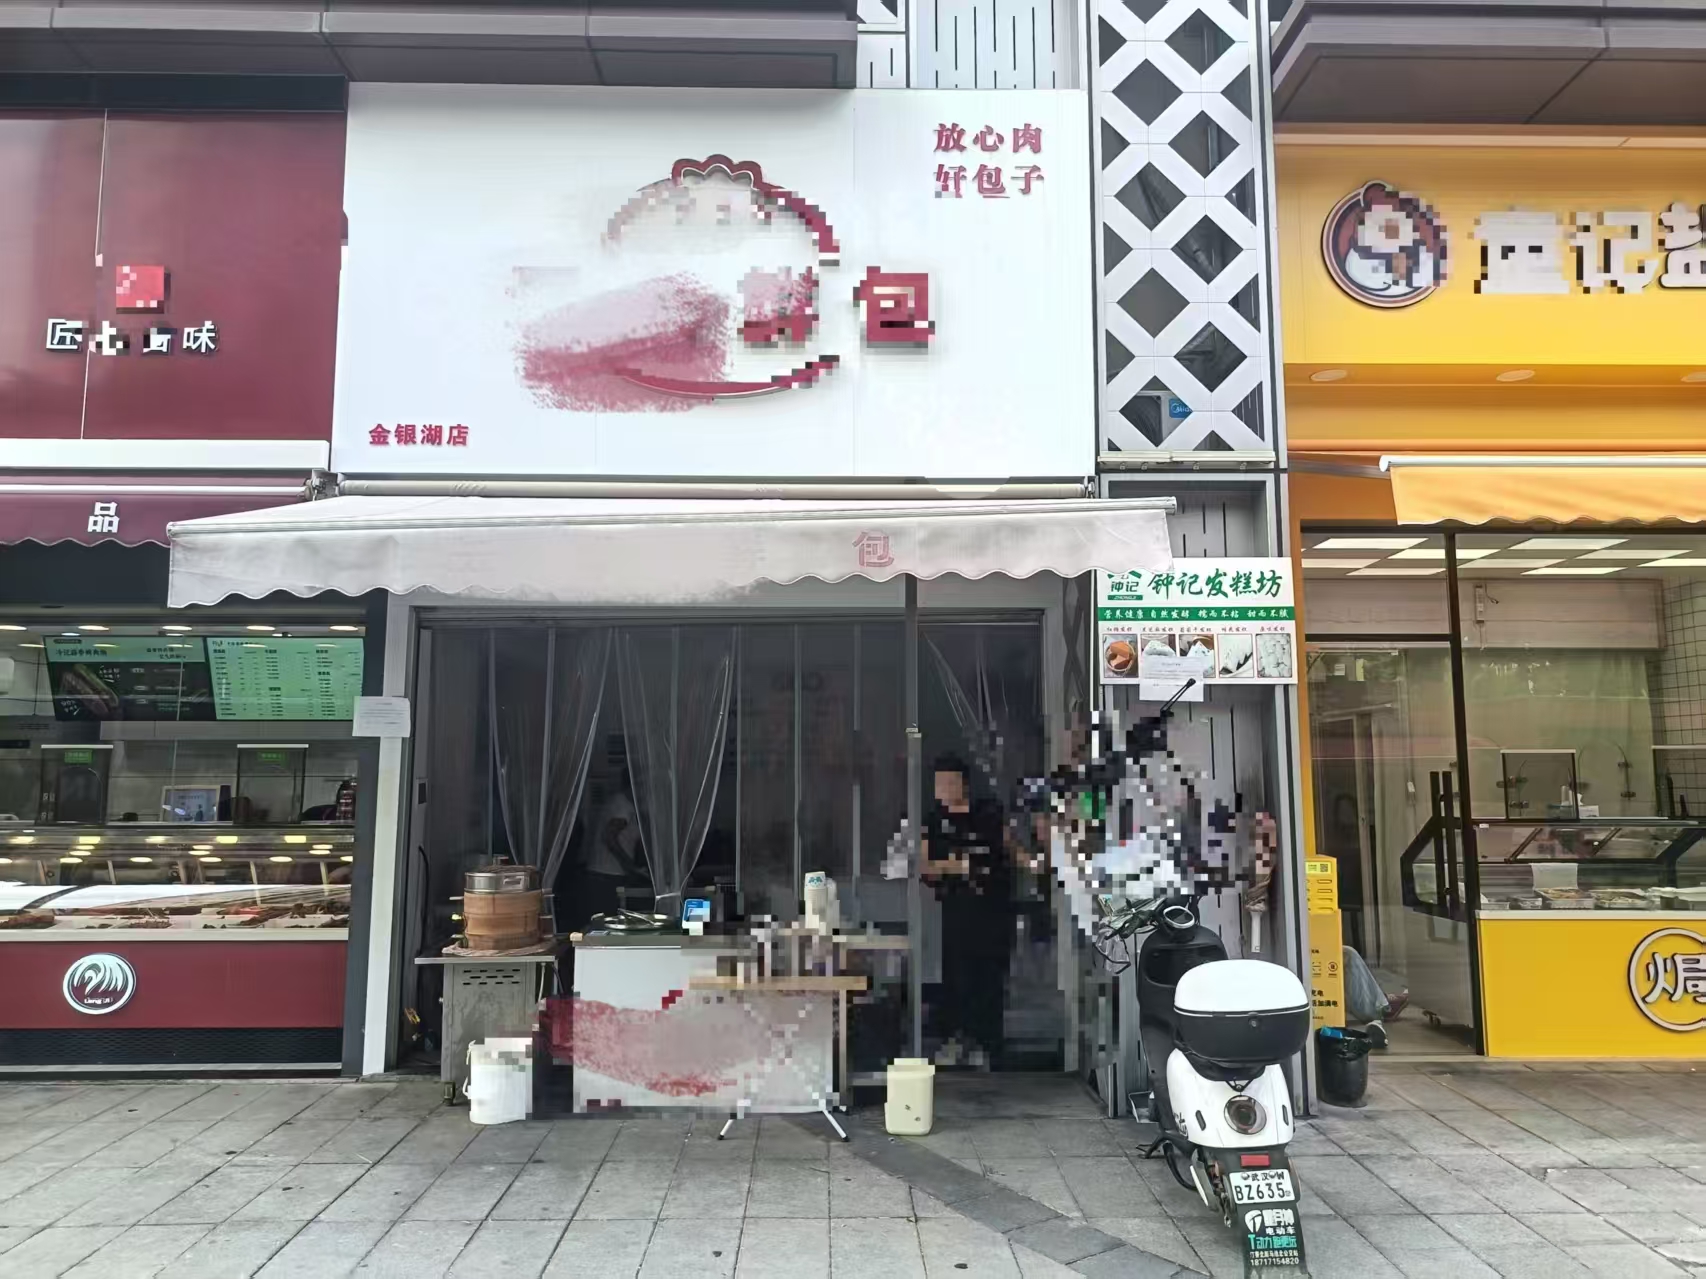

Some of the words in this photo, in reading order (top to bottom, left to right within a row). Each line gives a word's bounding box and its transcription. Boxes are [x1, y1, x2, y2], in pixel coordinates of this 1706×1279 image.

[933, 122, 1042, 154] 放心肉
[933, 163, 1045, 198] 好包子
[369, 422, 469, 446] 金银湖店
[87, 500, 120, 534] 品
[851, 530, 895, 568] 包
[1111, 581, 1140, 593] 钟记
[1148, 567, 1283, 600] 钟记发糕坊
[1103, 609, 1144, 619] 营养健康
[1234, 1182, 1286, 1201] BZ635
